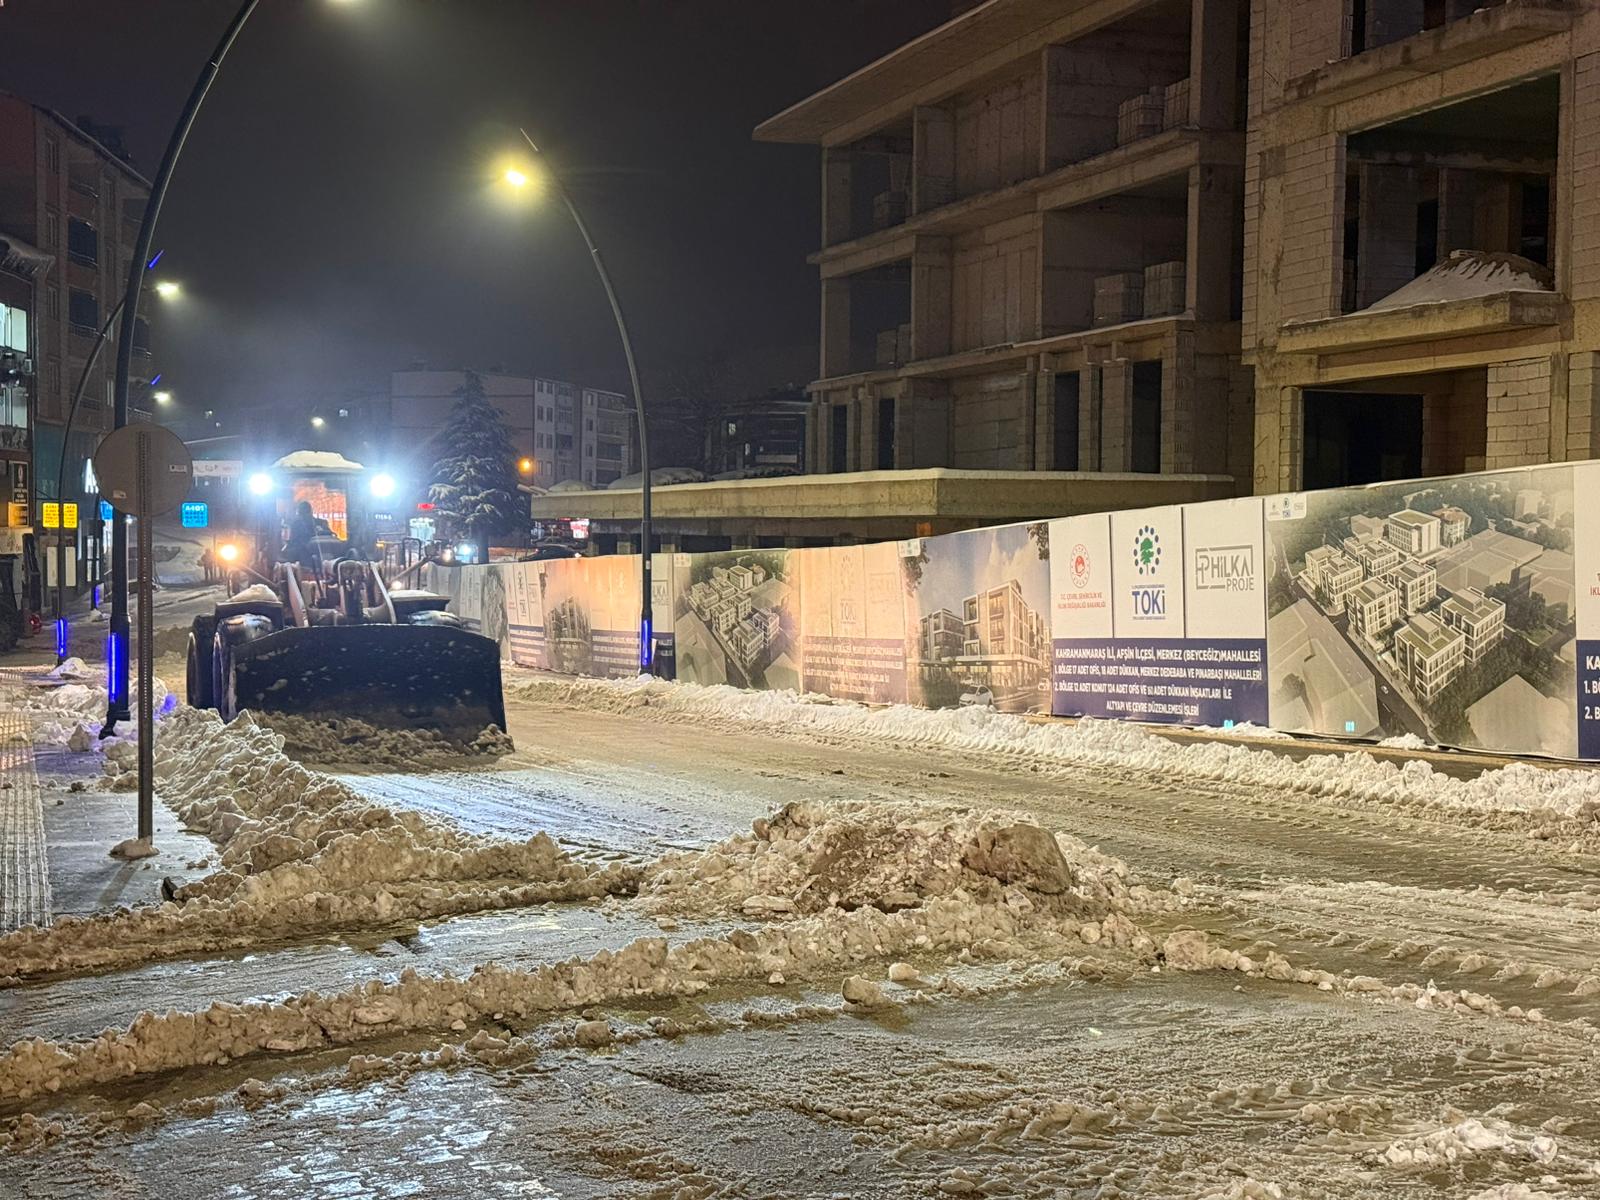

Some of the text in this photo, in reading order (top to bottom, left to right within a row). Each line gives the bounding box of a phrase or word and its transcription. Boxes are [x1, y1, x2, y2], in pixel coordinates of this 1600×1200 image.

[1226, 577, 1254, 592] PROJE
[1056, 648, 1105, 660] KAHRAMANMARAŞ
[1117, 646, 1134, 661] AFŞİN
[1157, 649, 1182, 660] MERKEZ
[1140, 667, 1159, 676] MERKEZ
[1187, 668, 1195, 678] VE
[1584, 680, 1590, 694] 1.
[1584, 705, 1593, 719] 2.
